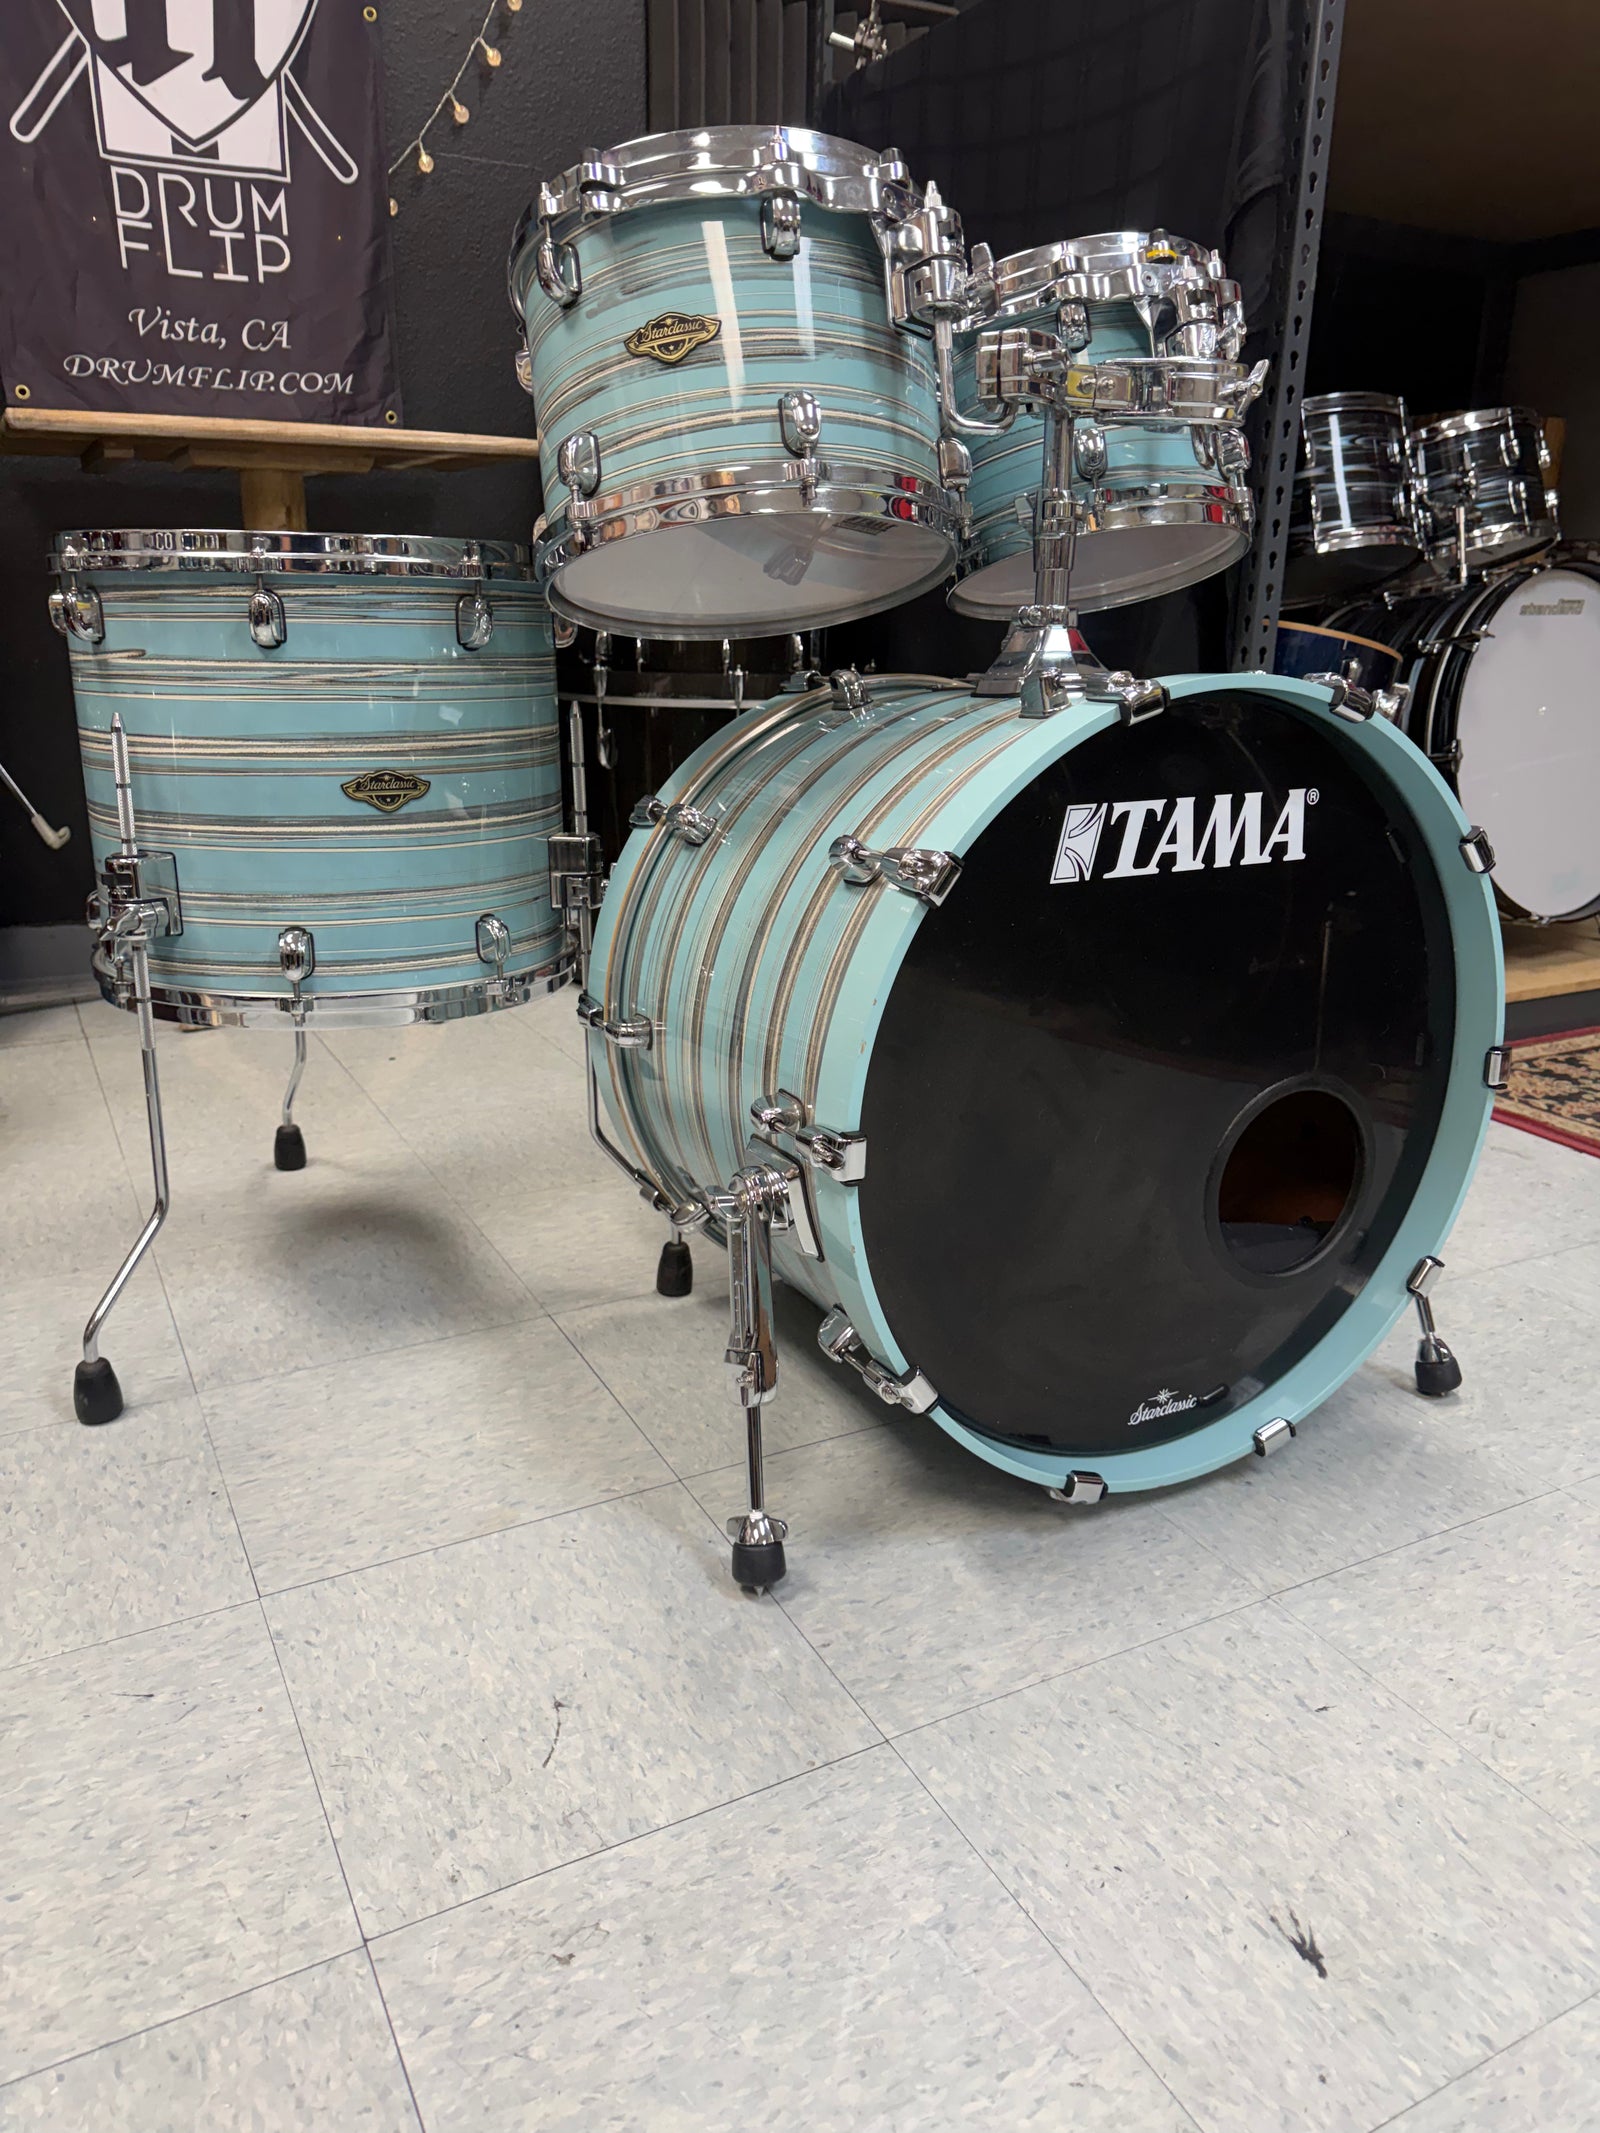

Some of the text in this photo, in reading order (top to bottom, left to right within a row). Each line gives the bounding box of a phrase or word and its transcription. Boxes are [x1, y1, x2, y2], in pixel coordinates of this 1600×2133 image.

[110, 165, 289, 236] DRUM
[116, 217, 291, 284] FLIP
[128, 306, 292, 351] Vista, CA
[641, 320, 703, 342] Starclassic
[63, 353, 354, 395] DRUMFLIP.COM
[359, 777, 415, 791] Starclassic
[1127, 1394, 1198, 1425] Starclassic
